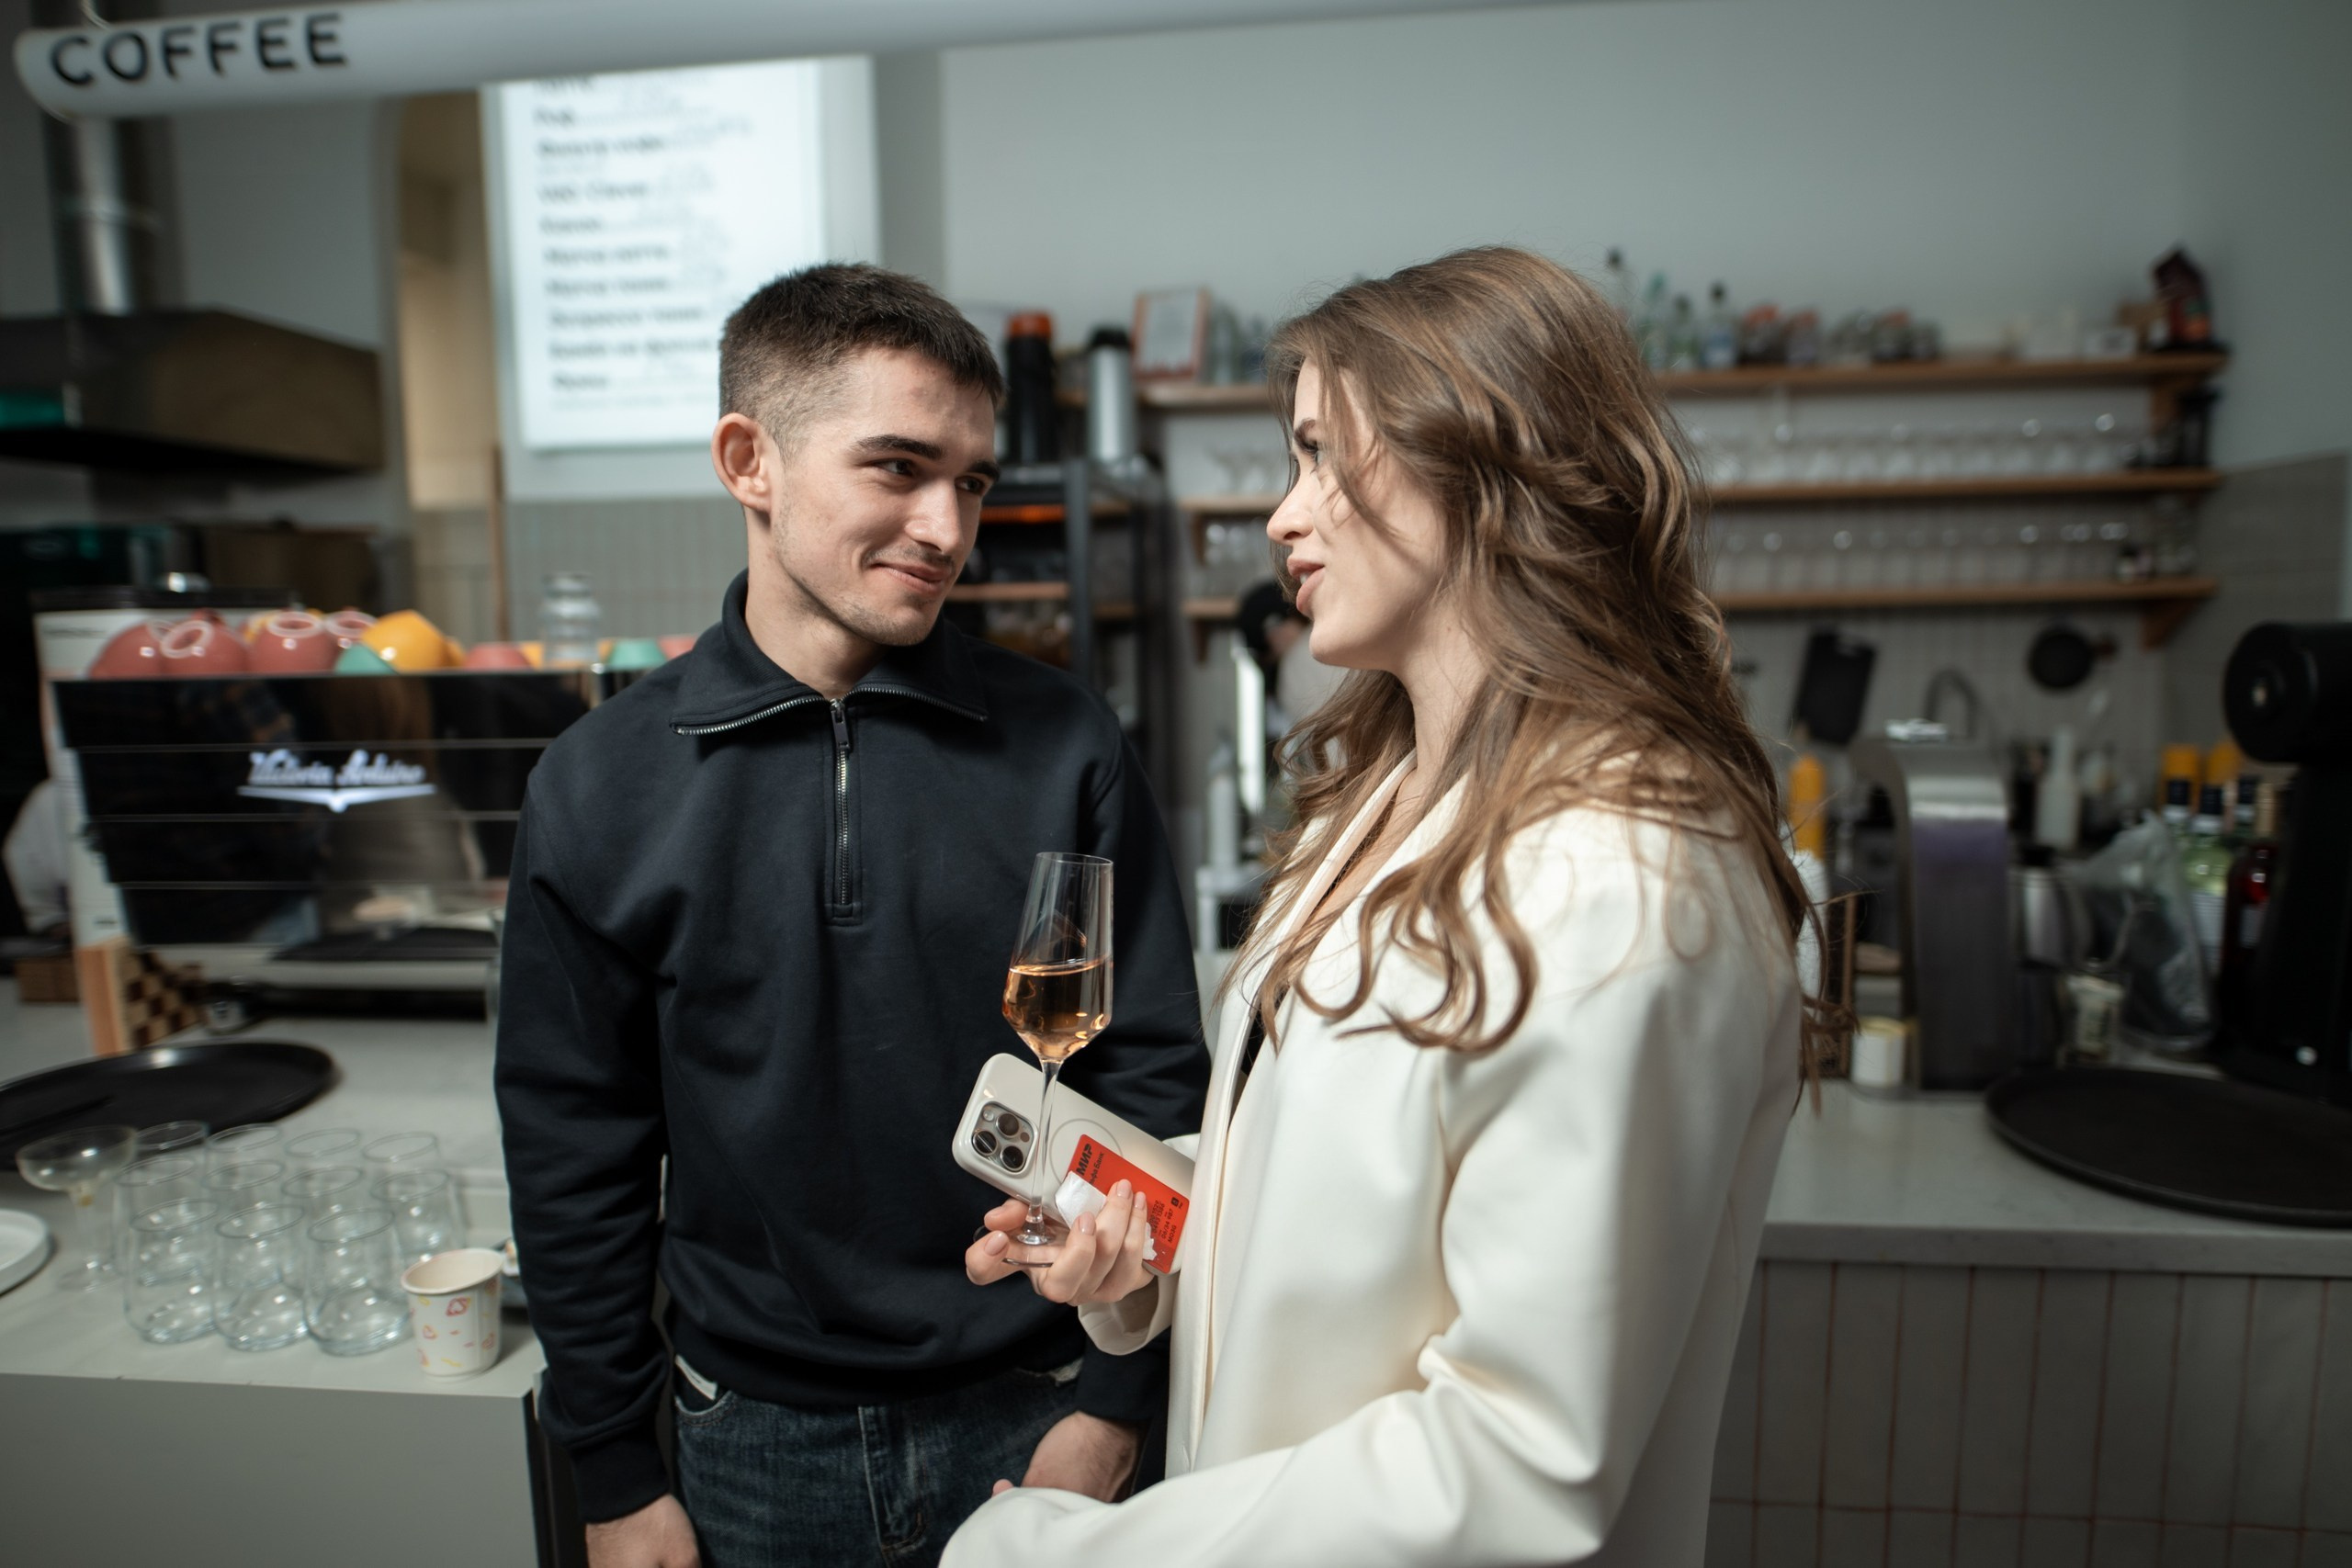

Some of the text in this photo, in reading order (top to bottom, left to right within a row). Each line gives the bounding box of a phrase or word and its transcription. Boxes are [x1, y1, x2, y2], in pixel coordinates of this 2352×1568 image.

[51, 13, 346, 85] COFFEE
[1076, 1143, 1092, 1176] МИР
[1093, 1152, 1104, 1169] Банк
